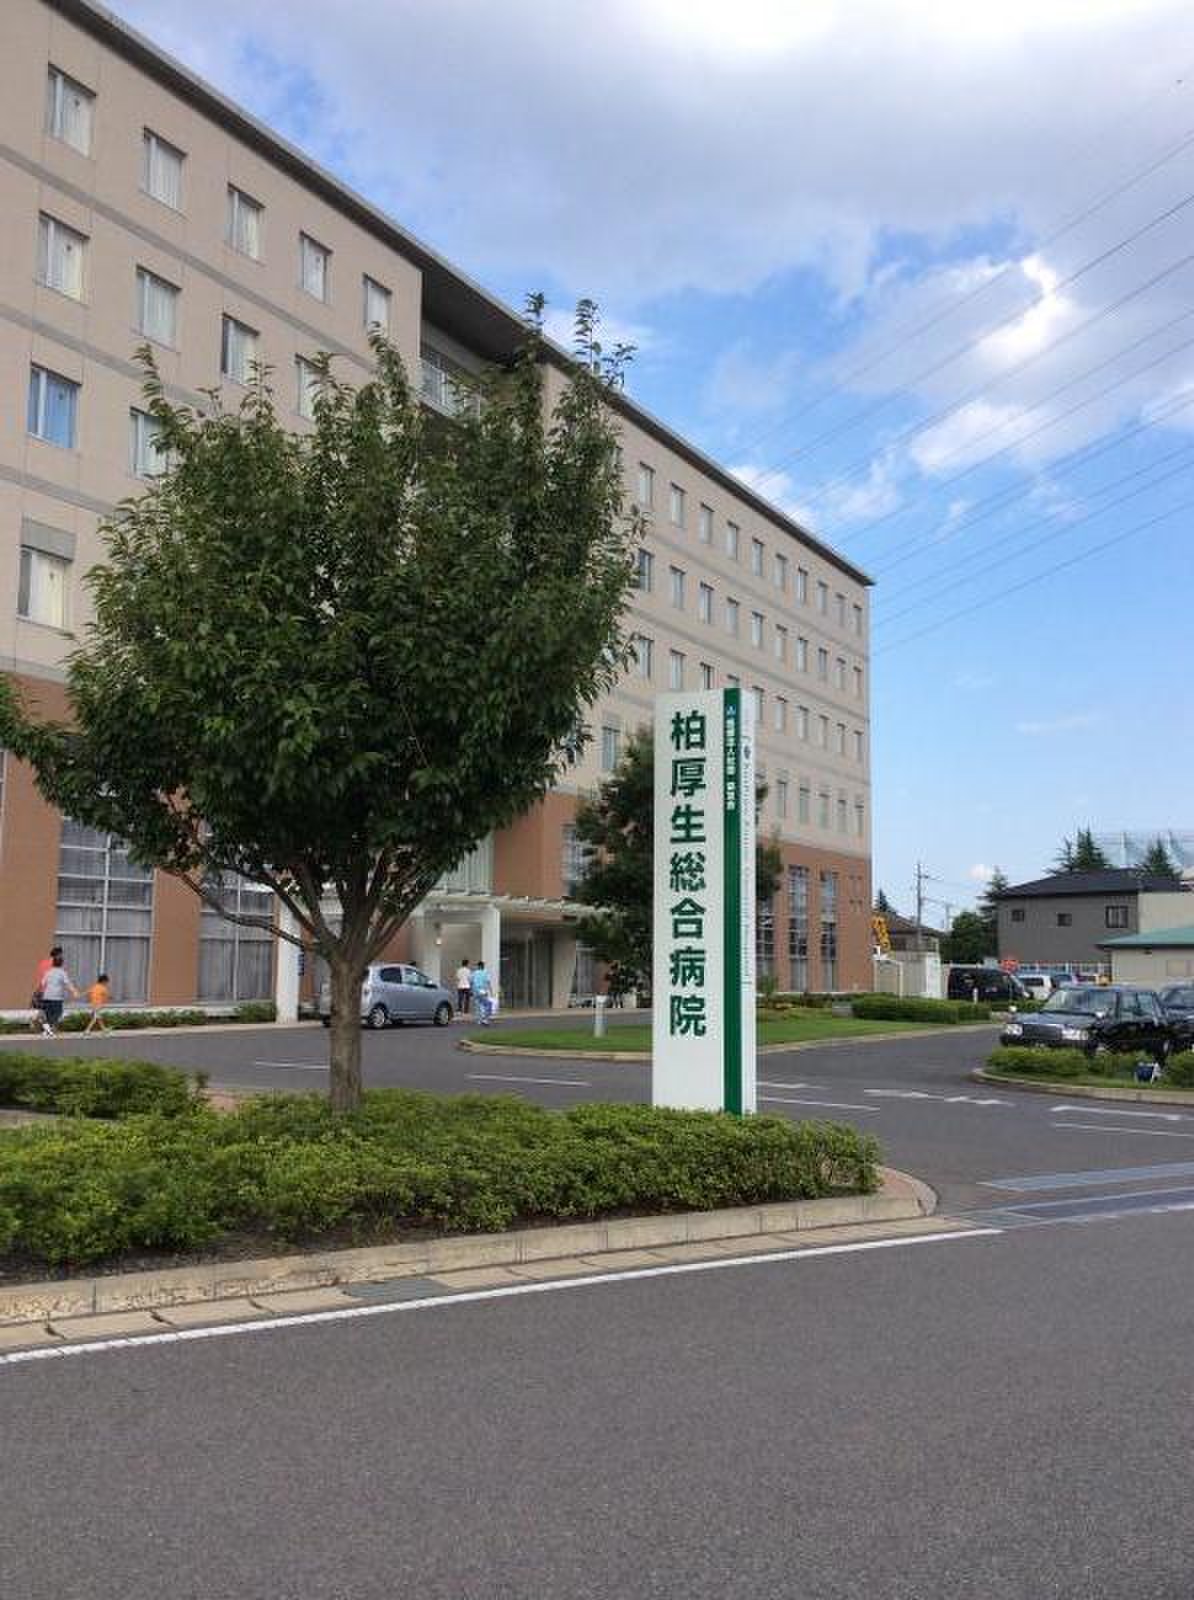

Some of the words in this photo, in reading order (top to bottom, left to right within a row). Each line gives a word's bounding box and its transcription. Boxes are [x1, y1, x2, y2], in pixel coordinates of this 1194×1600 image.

[669, 709, 707, 1038] 柏厚生総合病院
